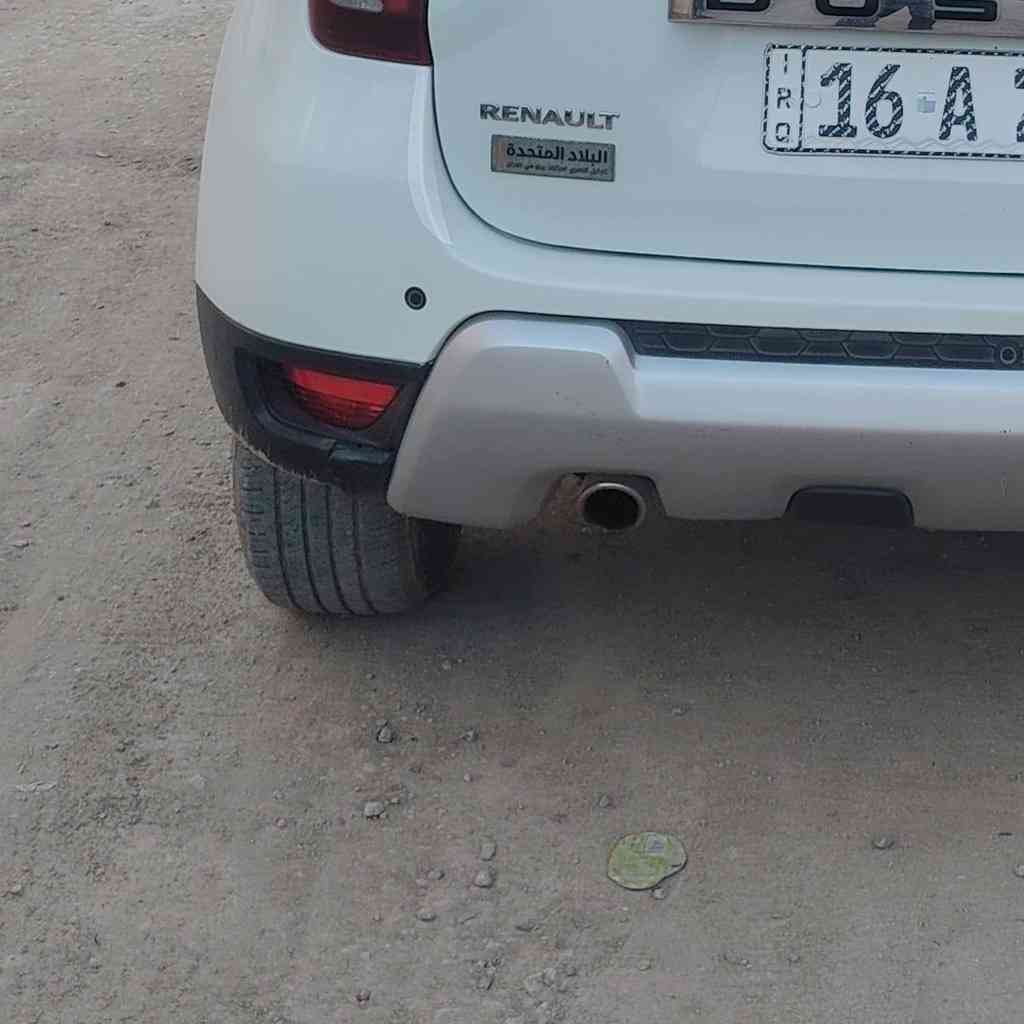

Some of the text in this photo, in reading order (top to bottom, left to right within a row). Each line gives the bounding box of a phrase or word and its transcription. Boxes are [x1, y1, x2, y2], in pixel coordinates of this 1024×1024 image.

[818, 62, 904, 138] 16
[939, 66, 978, 142] A
[479, 103, 621, 130] RENAULT
[506, 142, 608, 167] البلاد المتحدة
